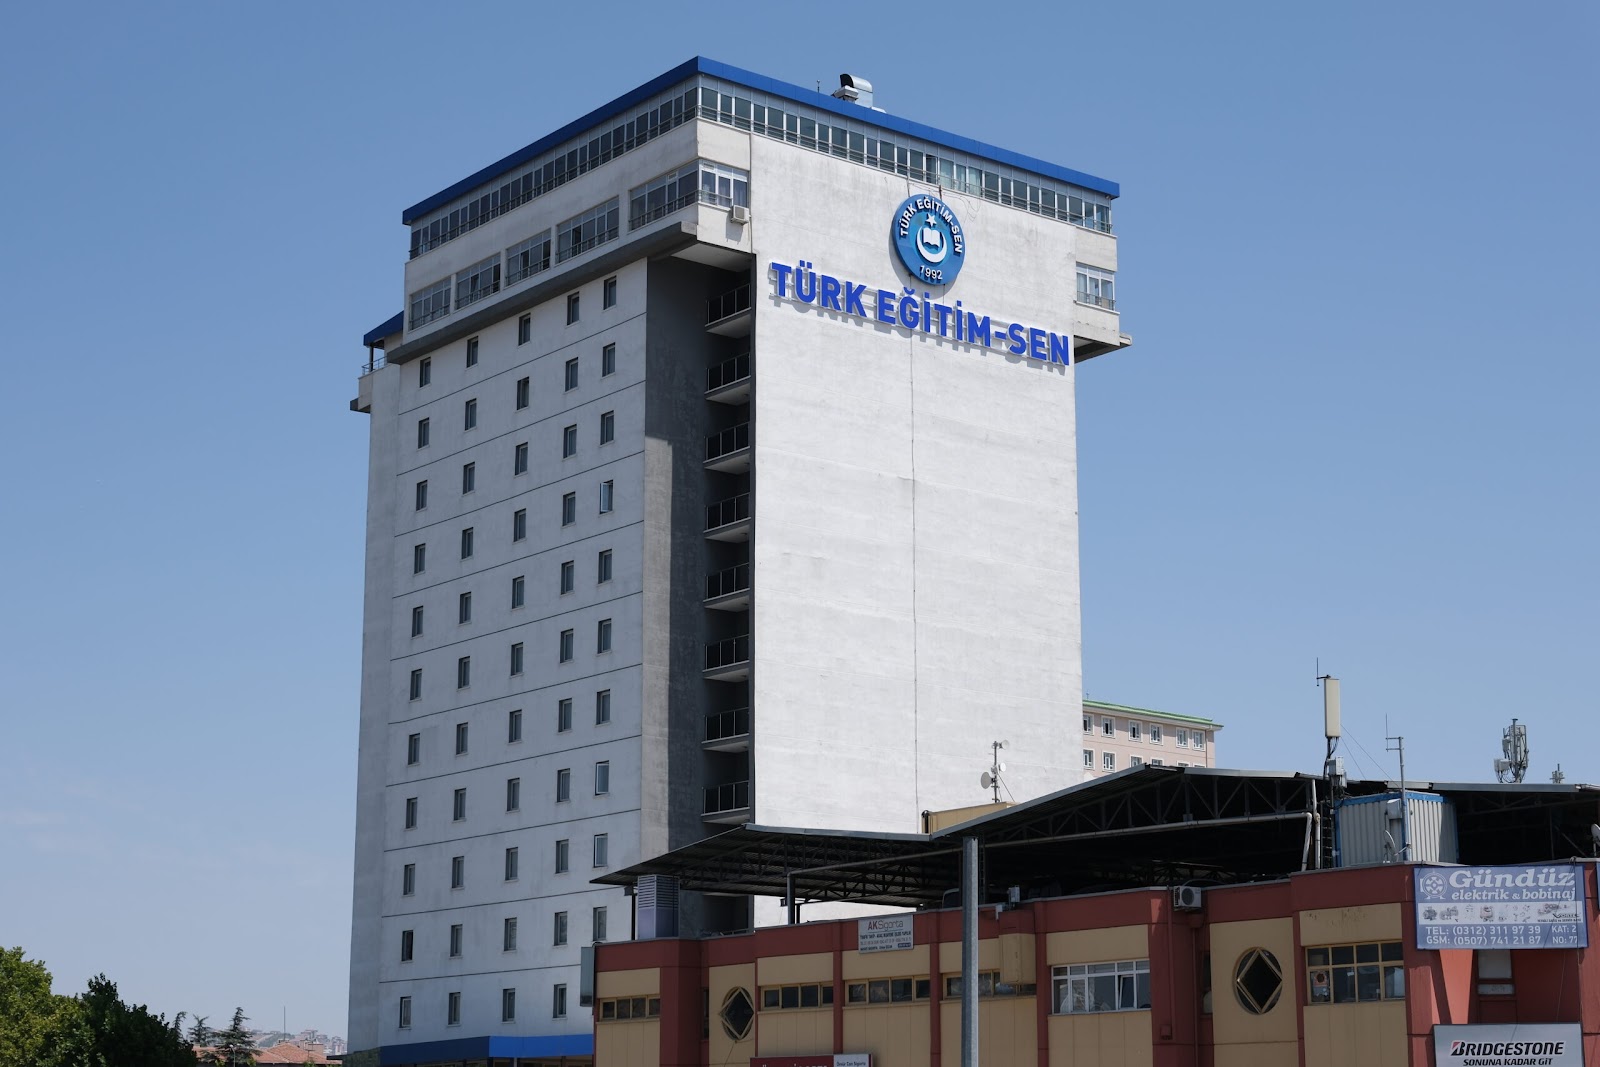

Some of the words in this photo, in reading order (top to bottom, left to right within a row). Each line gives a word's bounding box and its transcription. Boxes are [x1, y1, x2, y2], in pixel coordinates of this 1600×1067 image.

[899, 203, 918, 236] TÜRK
[916, 196, 963, 253] EĞİTİM-SEN
[920, 265, 943, 280] 1992
[771, 260, 867, 318] TÜRK
[877, 287, 1070, 366] EĞİTİM-SEN
[1449, 868, 1575, 888] Gündüz
[1451, 888, 1509, 900] elektrik
[1522, 887, 1576, 901] bobinaj
[1426, 926, 1449, 935] TEL:
[1452, 925, 1487, 936] (0312)
[1490, 925, 1508, 934] 311
[1512, 925, 1525, 934] 97
[1528, 925, 1541, 934] 39
[1551, 925, 1570, 933] KAT:
[1571, 925, 1577, 933] 2
[1426, 936, 1450, 945] GSM:
[1453, 936, 1487, 946] (0507)
[1490, 936, 1509, 945] 741
[1513, 936, 1525, 945] 21
[1528, 936, 1541, 944] 87
[1552, 936, 1567, 944] NO:
[1451, 1041, 1564, 1056] BRIDGESTONE
[1463, 1058, 1502, 1066] SONUNA
[1504, 1058, 1536, 1066] KADAR
